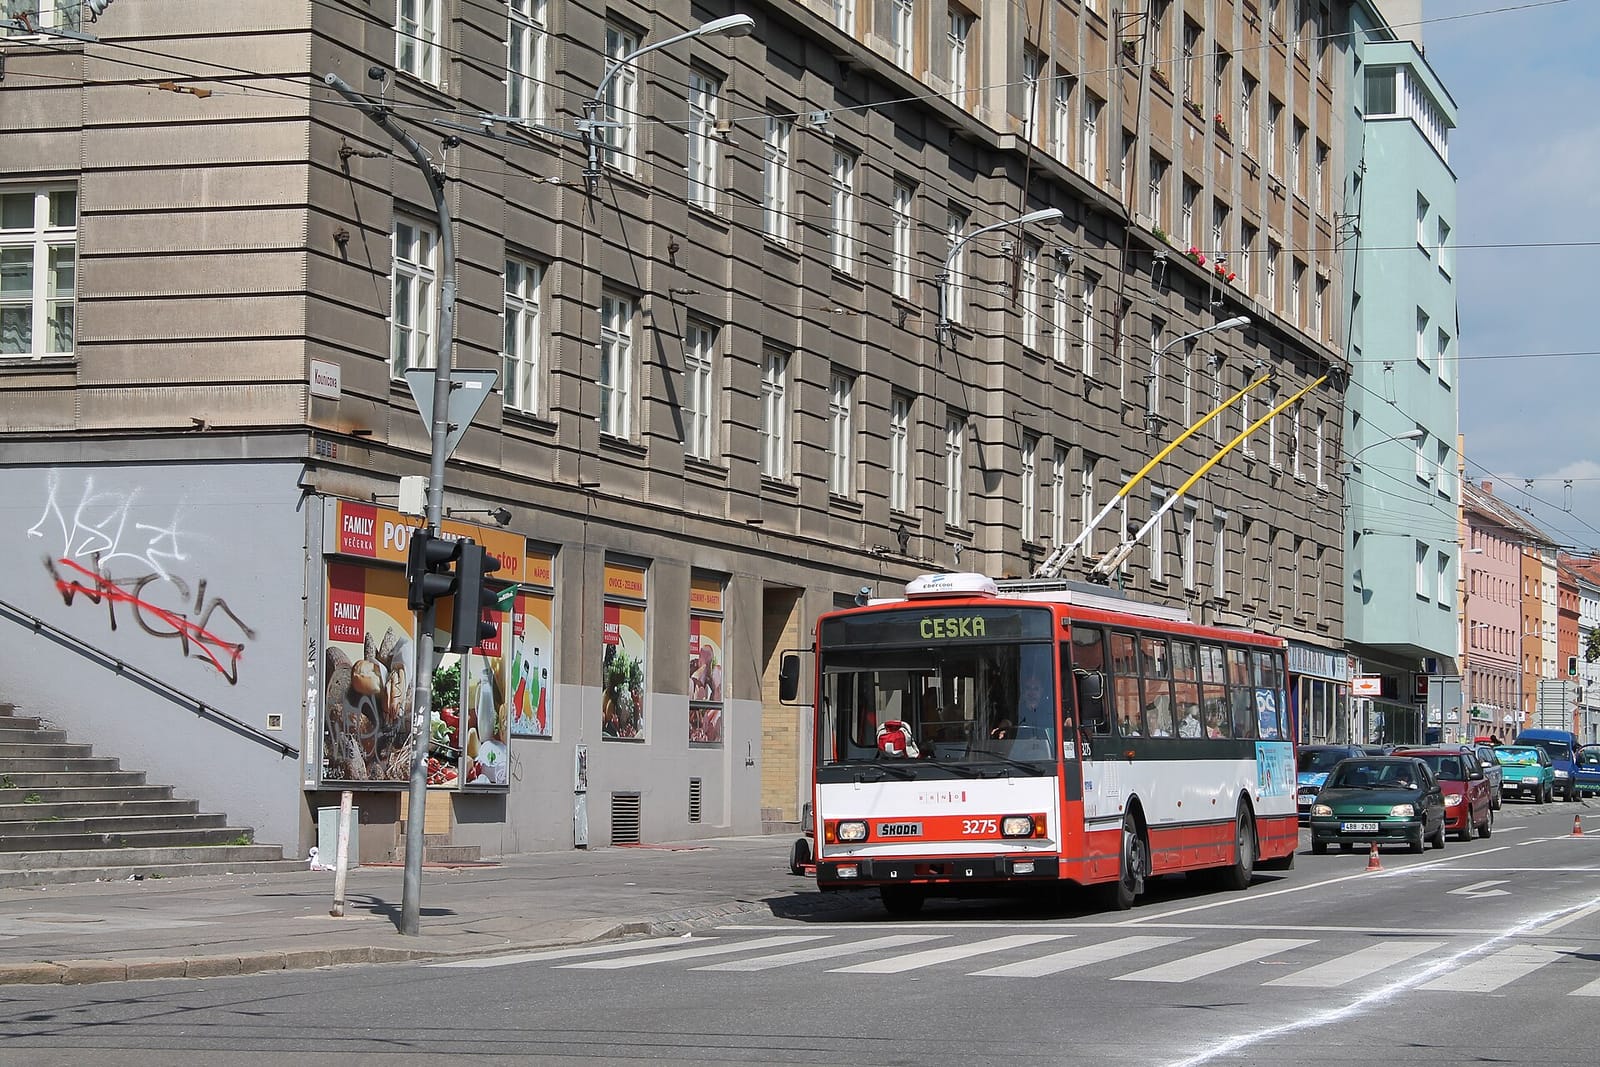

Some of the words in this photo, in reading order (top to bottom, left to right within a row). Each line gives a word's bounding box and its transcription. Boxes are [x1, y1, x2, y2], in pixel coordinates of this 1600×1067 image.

[343, 514, 374, 536] FAMILY
[343, 536, 373, 550] VEČERKA
[333, 602, 361, 620] FAMILY
[333, 624, 361, 636] VEČERKA
[920, 615, 986, 639] ČESKÁ
[882, 823, 918, 836] ŠKODA
[962, 819, 997, 834] 3275
